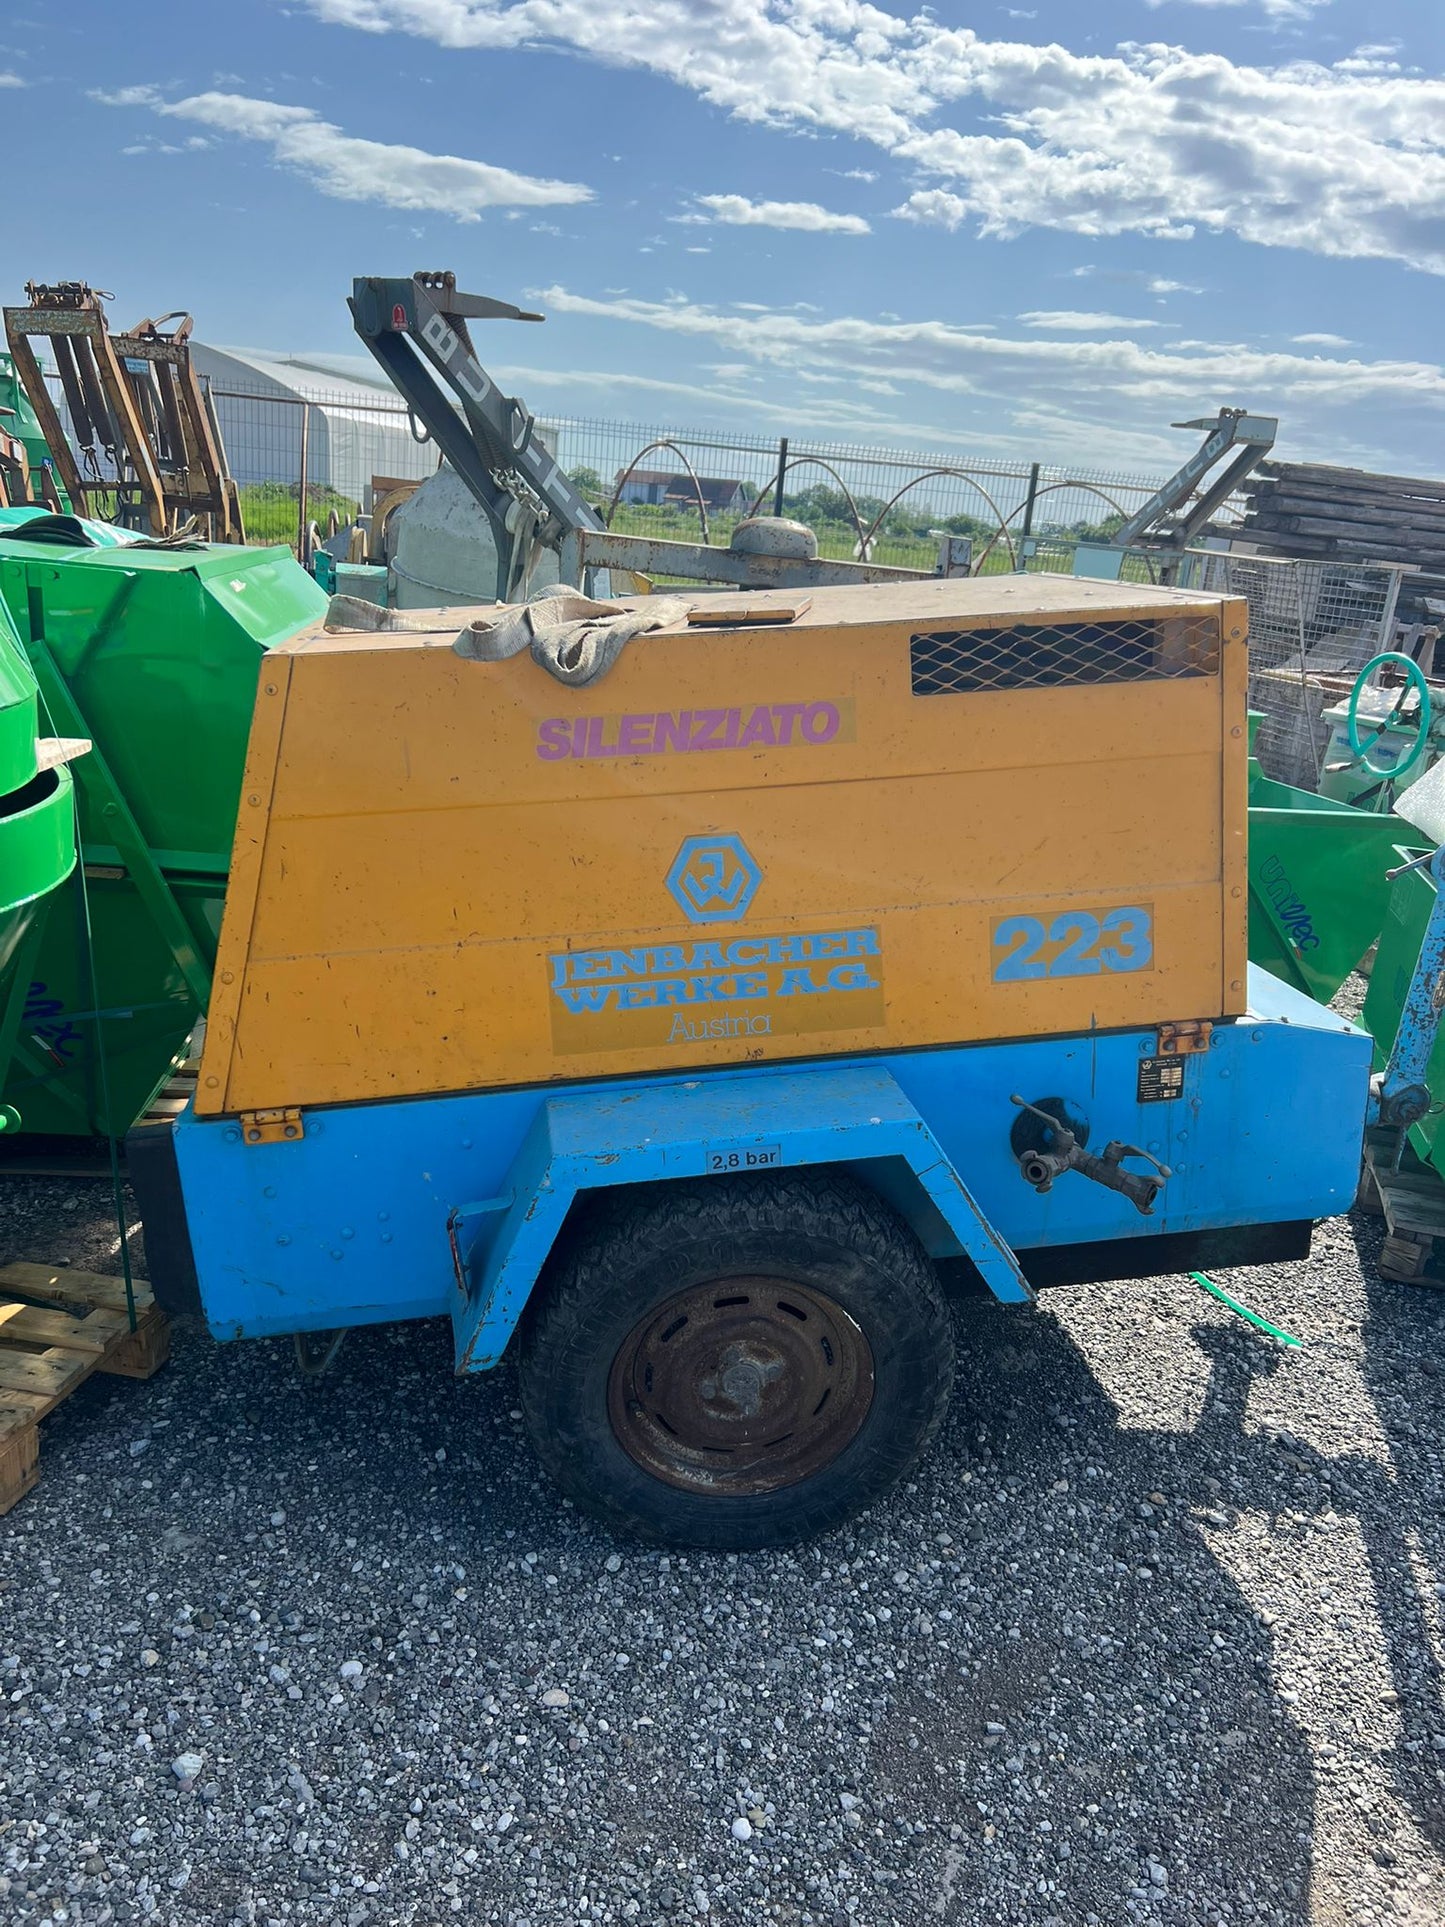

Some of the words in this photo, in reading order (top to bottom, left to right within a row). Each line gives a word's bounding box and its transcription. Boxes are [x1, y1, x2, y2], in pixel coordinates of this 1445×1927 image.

[536, 701, 841, 761] SILENZIATO
[549, 928, 882, 988] JENBACHER
[994, 906, 1152, 982] 223
[554, 972, 769, 1015] WERKE
[775, 963, 881, 997] A.G.
[666, 1010, 772, 1044] Austria
[712, 1153, 739, 1170] 2,8
[746, 1151, 776, 1166] bar
